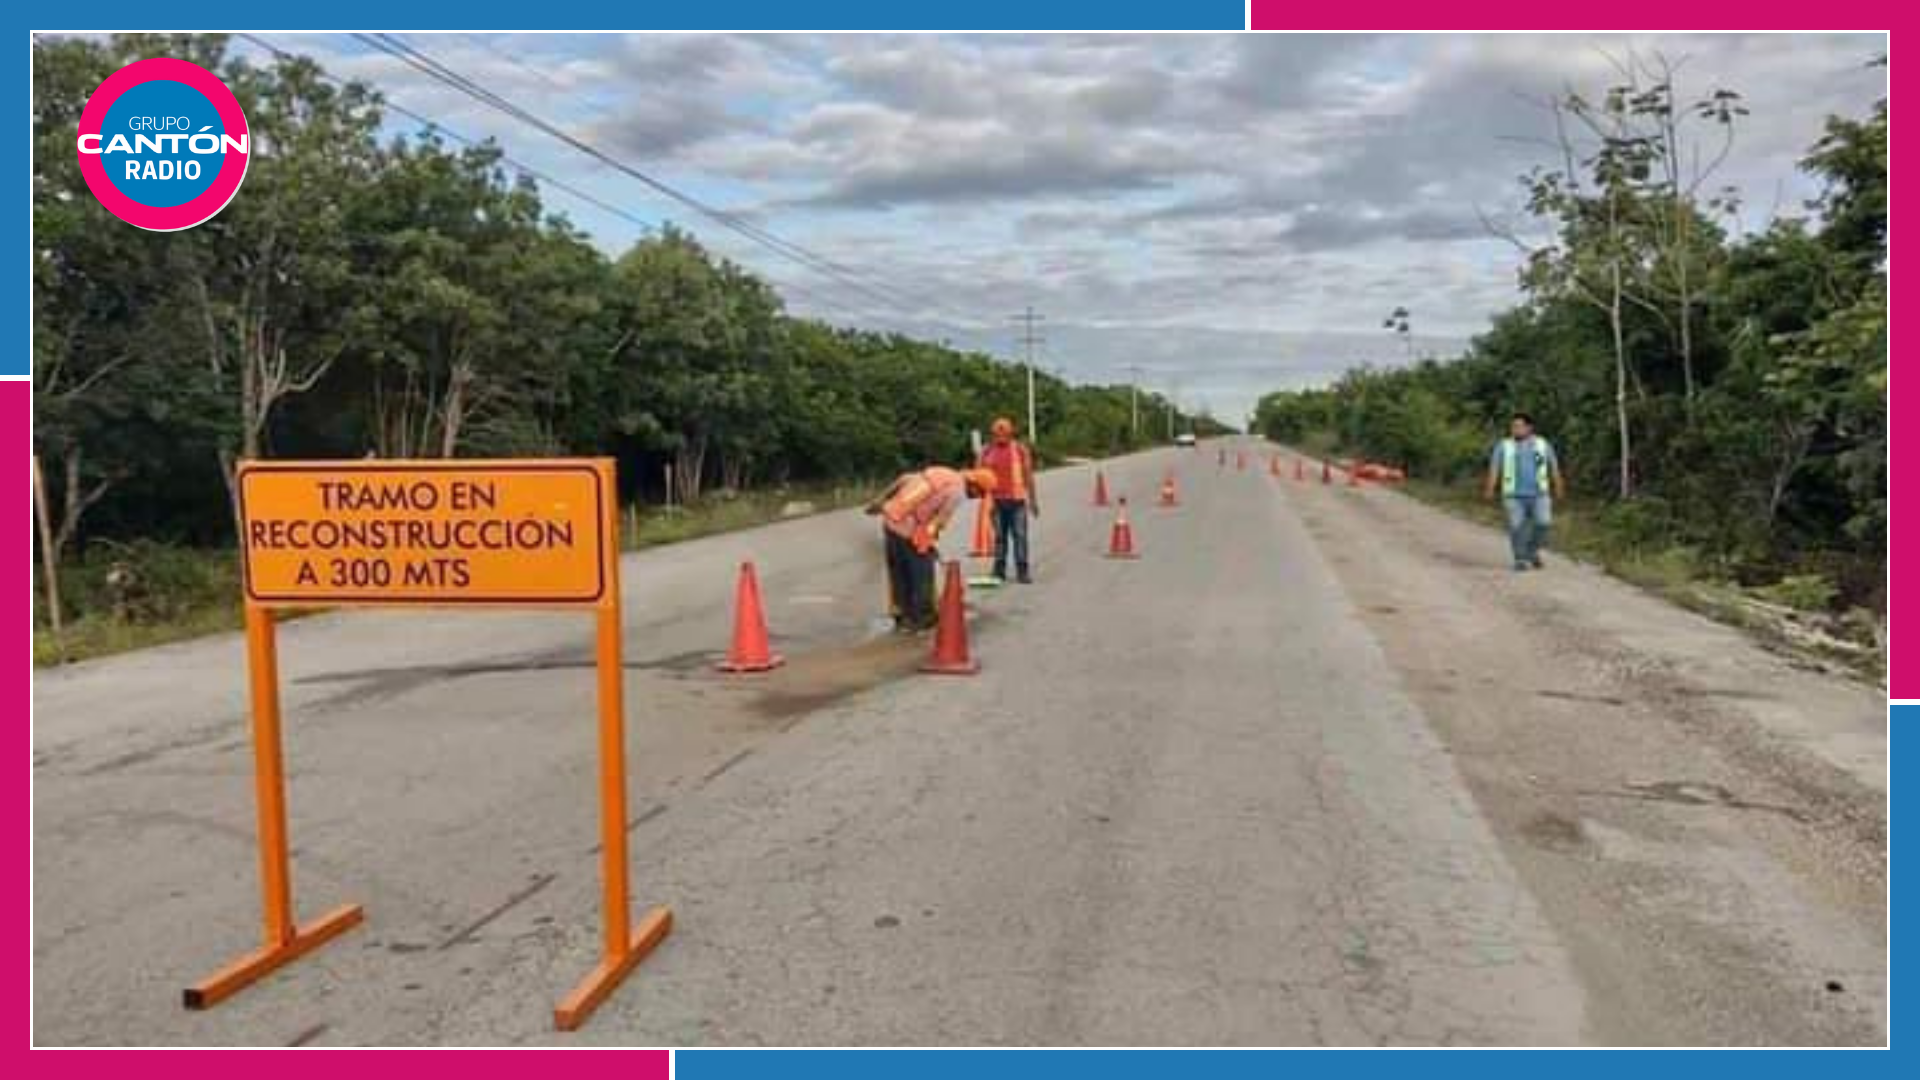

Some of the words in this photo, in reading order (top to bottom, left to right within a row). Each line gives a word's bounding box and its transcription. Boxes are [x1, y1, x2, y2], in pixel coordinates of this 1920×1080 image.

[318, 481, 438, 511] TRAMO
[451, 482, 495, 510] EN
[250, 513, 573, 550] RECONSTRUCCIÓN
[296, 559, 318, 586] A
[330, 559, 391, 587] 300
[403, 559, 470, 587] MTS
